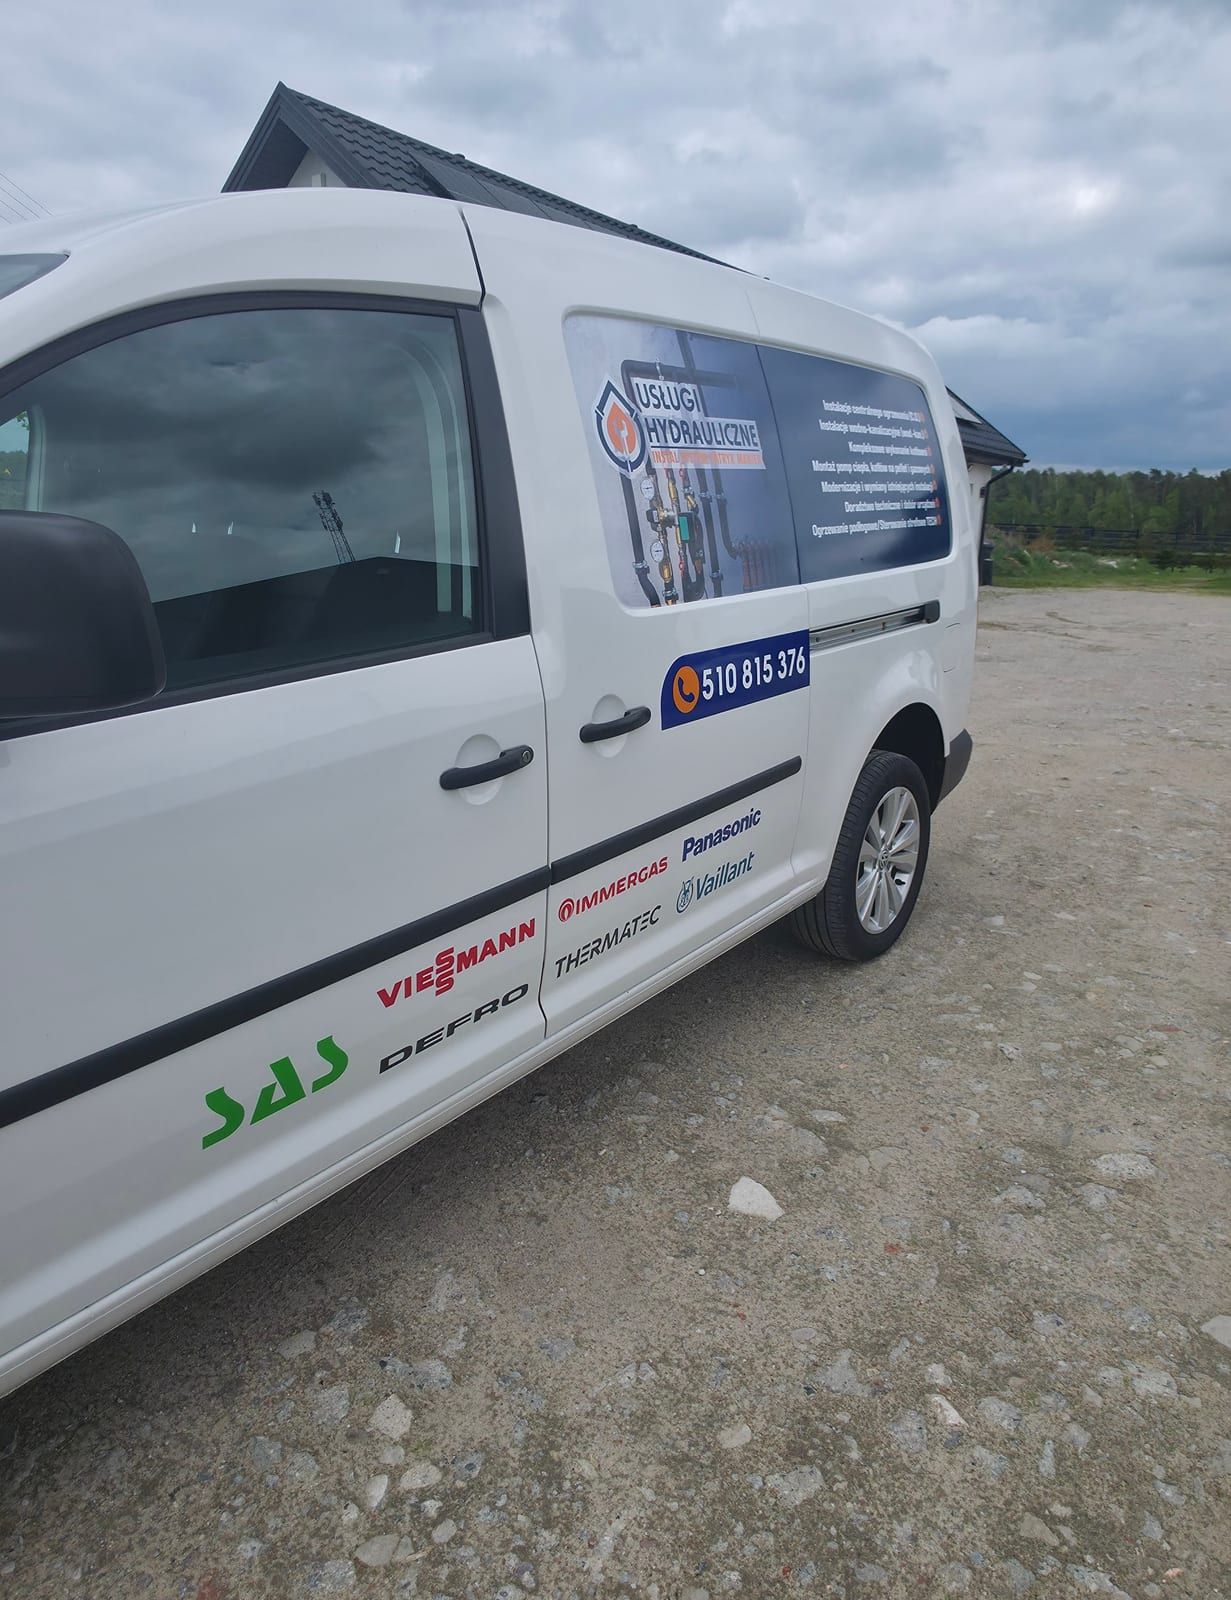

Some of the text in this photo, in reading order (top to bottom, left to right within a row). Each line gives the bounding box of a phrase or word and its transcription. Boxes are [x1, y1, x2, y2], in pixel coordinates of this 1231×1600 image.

[635, 382, 701, 412] USŁUGI
[822, 399, 852, 415] Instalacje
[644, 417, 759, 447] HYDRAULICZNE
[818, 419, 849, 434] Instalacje
[812, 460, 836, 473] Montaż
[836, 463, 852, 474] pomp
[821, 481, 861, 494] Modernizacje
[844, 501, 874, 513] Doradztwo
[812, 522, 849, 539] Ogrzewanie
[702, 646, 806, 701] 510 815 376
[682, 807, 761, 862] Panasonic
[576, 856, 669, 916] IMMERGAS
[694, 851, 755, 901] Vaillant
[554, 905, 662, 980] THERMATEC
[379, 983, 529, 1075] DEFRO
[202, 1035, 349, 1151] SAS
